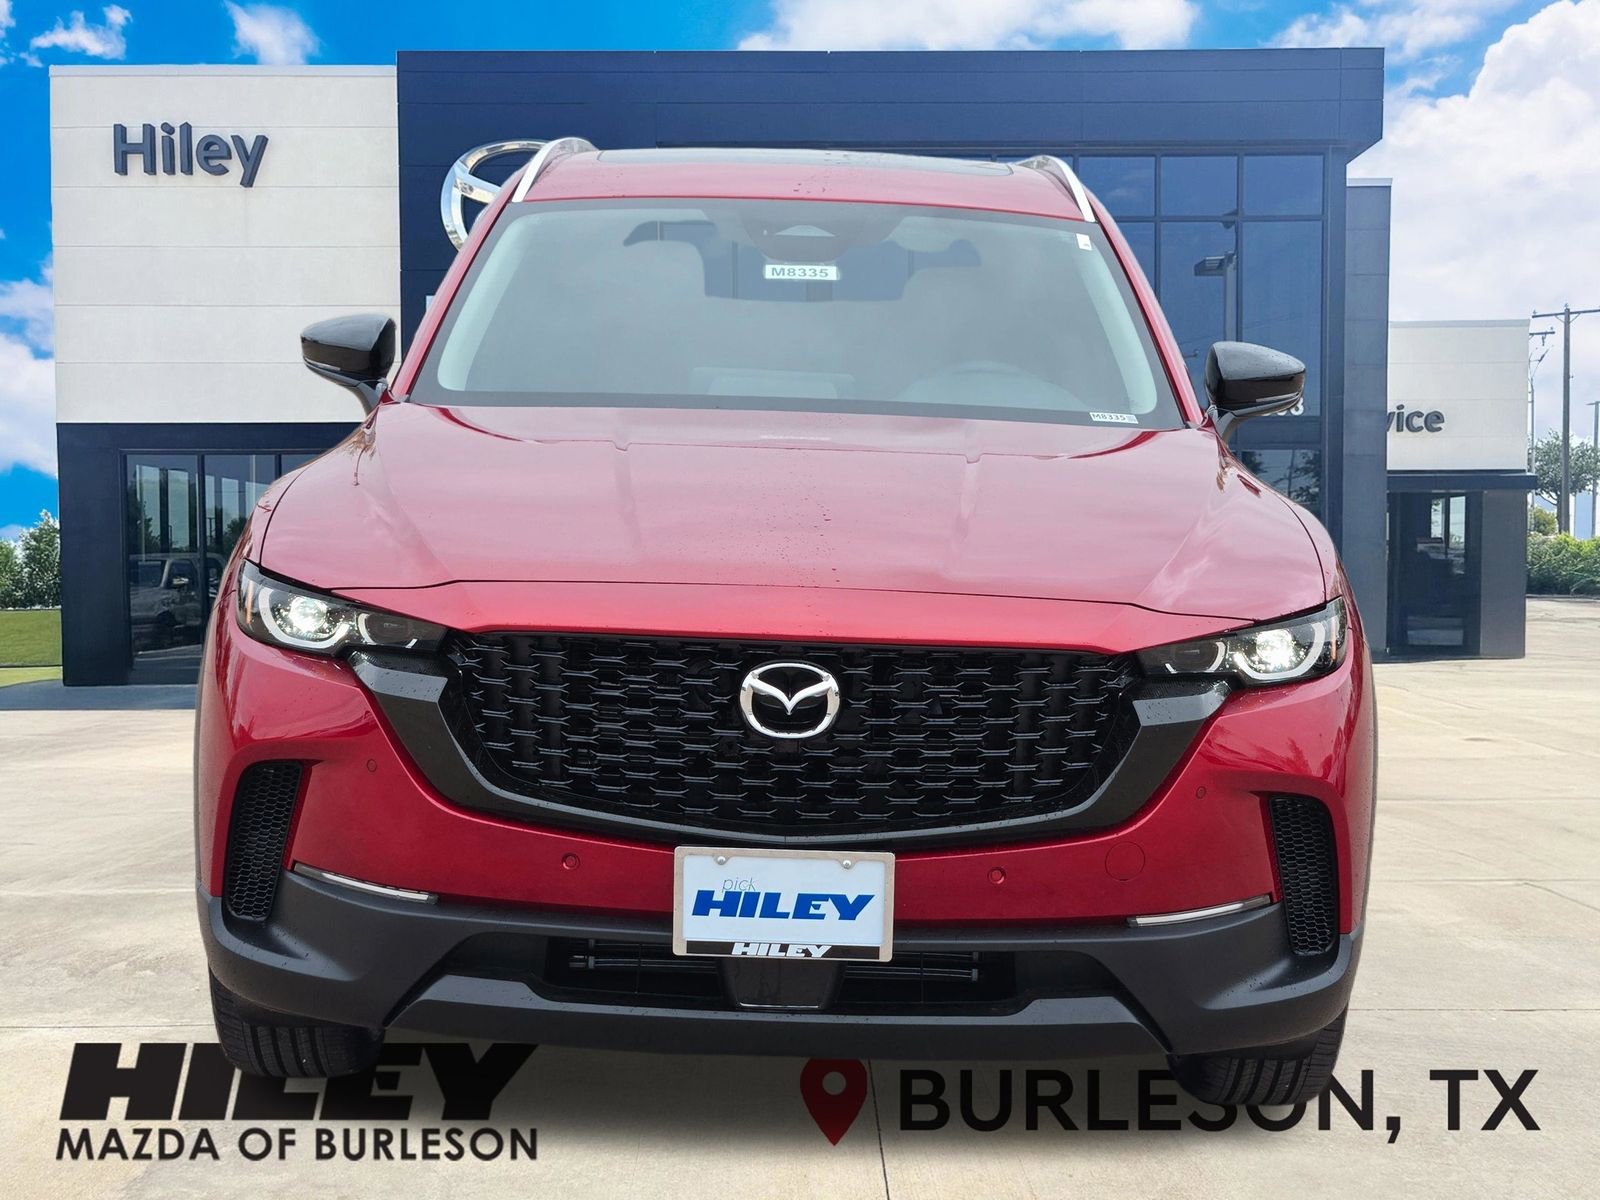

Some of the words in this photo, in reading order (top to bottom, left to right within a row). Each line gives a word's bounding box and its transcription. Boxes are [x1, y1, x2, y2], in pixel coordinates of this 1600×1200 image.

[113, 121, 269, 188] Hiley
[770, 266, 830, 278] M8335
[722, 877, 756, 893] pick
[691, 889, 876, 921] HILEY
[731, 942, 832, 959] HILEY
